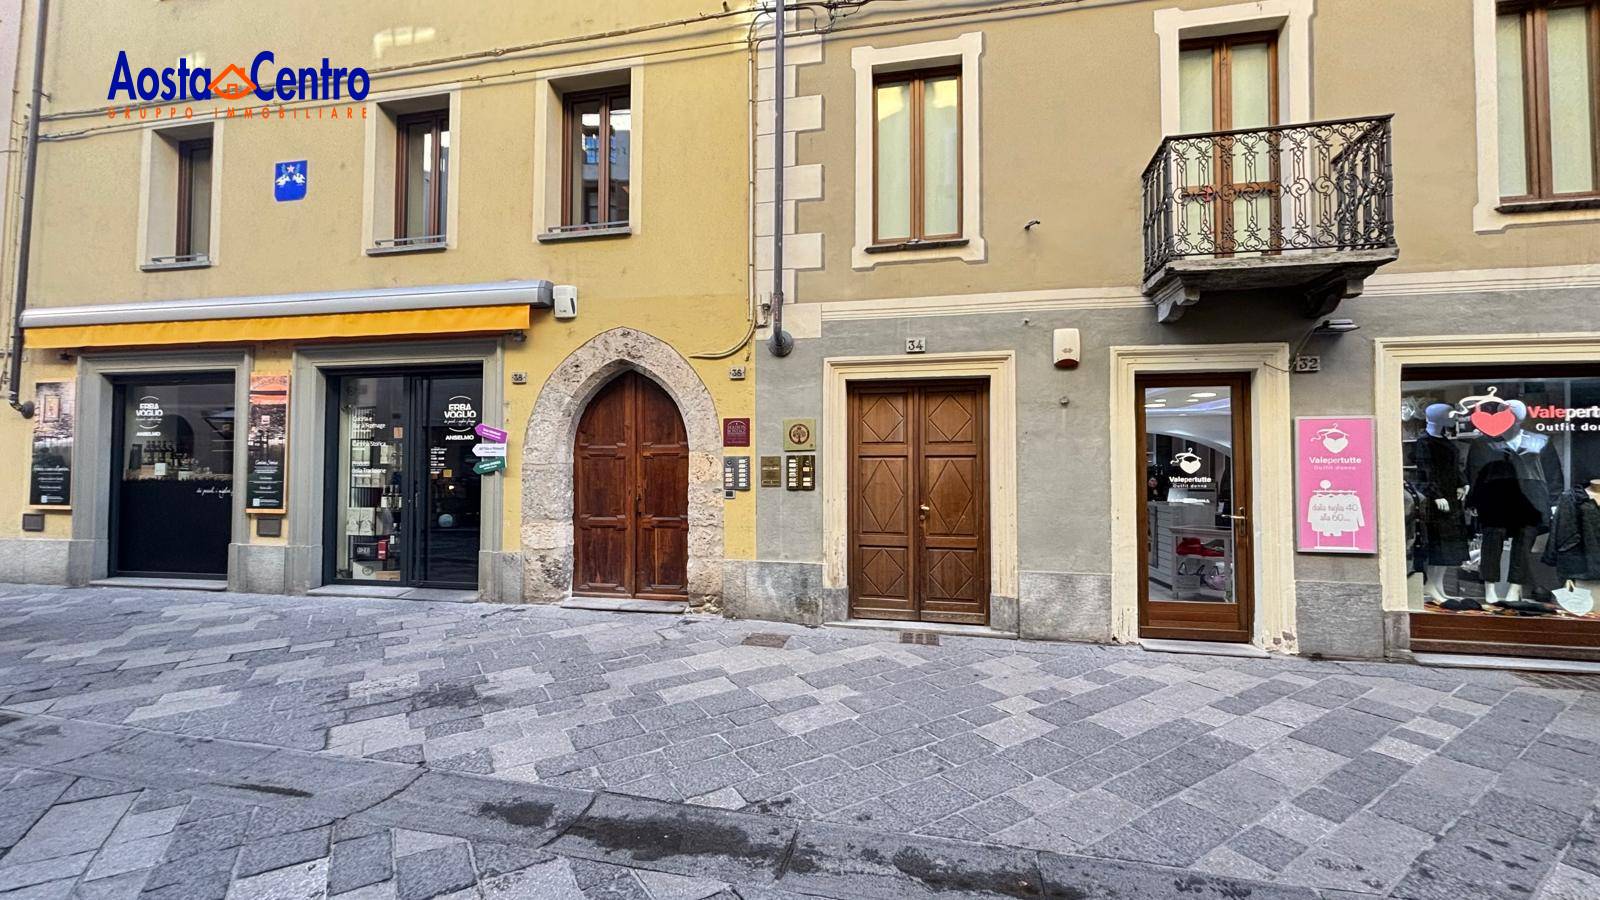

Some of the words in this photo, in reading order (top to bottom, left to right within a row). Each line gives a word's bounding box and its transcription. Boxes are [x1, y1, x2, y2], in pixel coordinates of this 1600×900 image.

[908, 340, 923, 350] 34
[1299, 358, 1318, 369] 32
[449, 403, 471, 411] ERBA
[443, 410, 476, 419] VOGLIO
[1535, 422, 1576, 431] Outfit
[1580, 422, 1600, 431] do
[1309, 456, 1361, 465] Valepertutte
[1168, 476, 1212, 484] Valepertutte
[1345, 503, 1359, 512] 40
